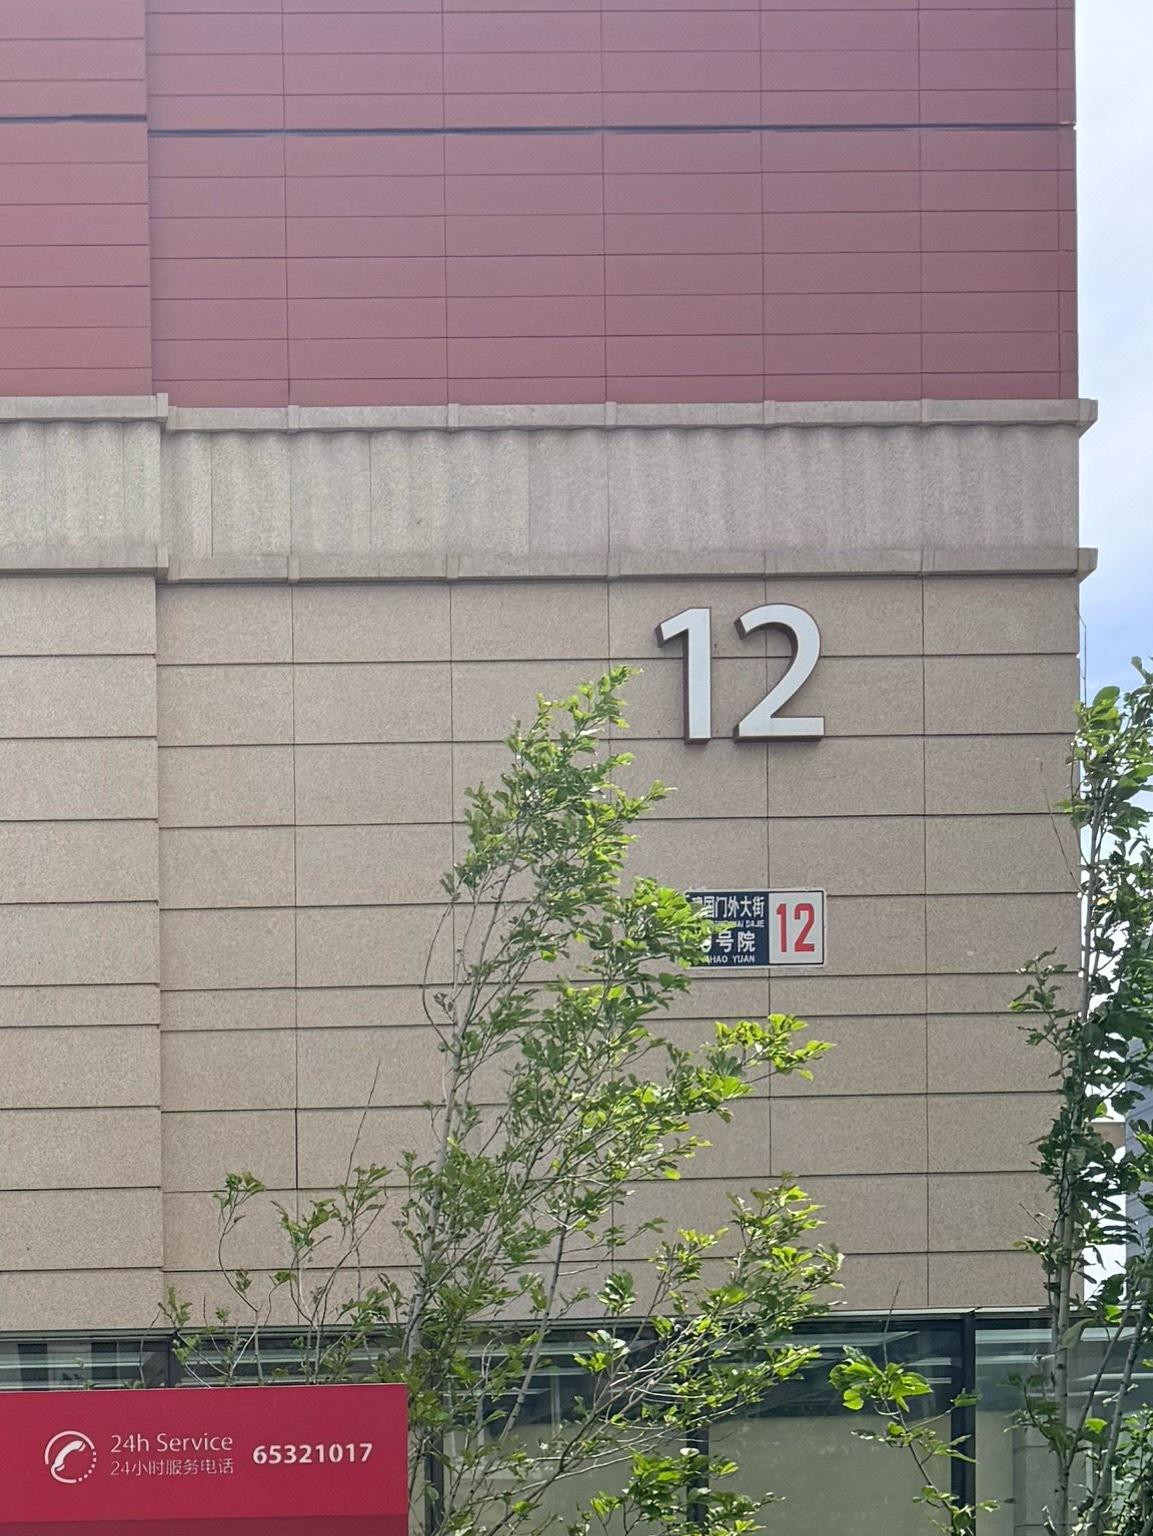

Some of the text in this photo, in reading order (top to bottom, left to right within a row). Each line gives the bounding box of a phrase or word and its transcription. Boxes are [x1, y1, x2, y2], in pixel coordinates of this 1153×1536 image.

[656, 603, 825, 743] 12
[776, 903, 815, 953] 12
[732, 954, 756, 964] YUAN
[110, 1431, 234, 1453] 24h Service
[252, 1443, 374, 1465] 65321017
[110, 1458, 235, 1477] 24小时服务电话
